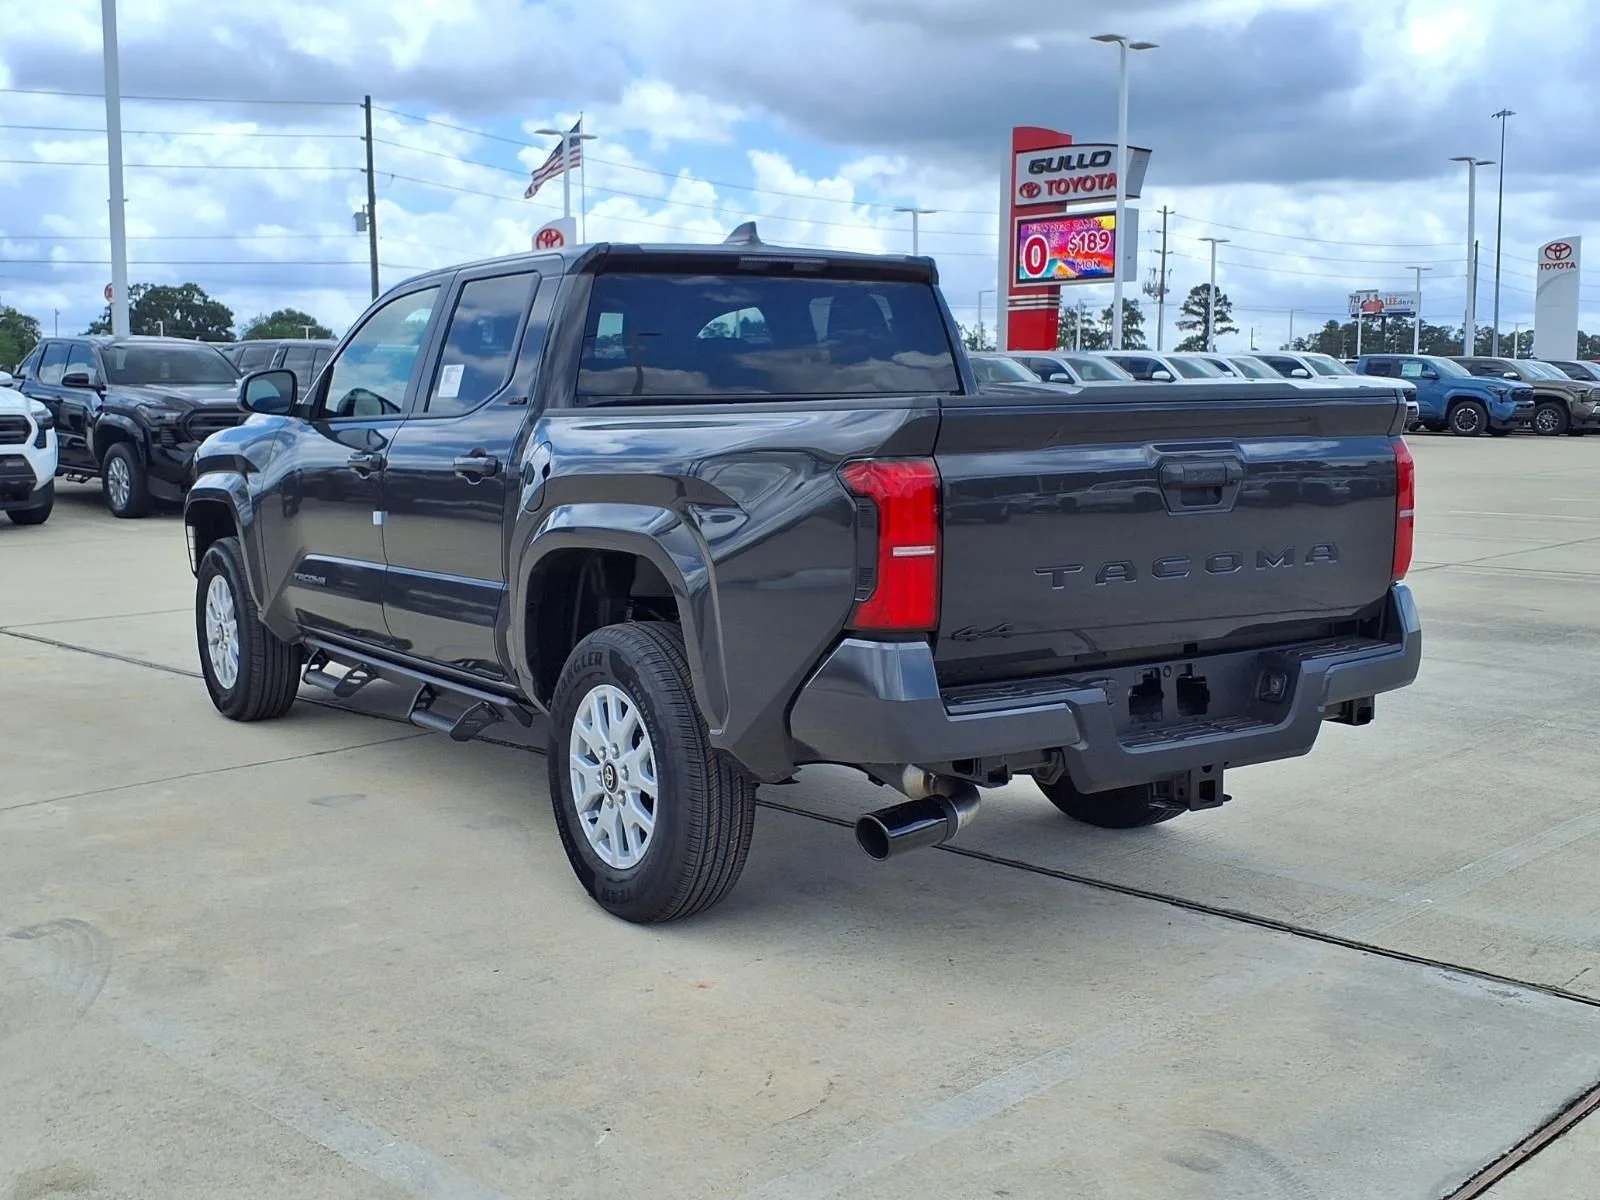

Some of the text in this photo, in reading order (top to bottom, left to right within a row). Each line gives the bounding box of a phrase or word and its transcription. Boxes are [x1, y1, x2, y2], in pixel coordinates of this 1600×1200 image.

[1028, 150, 1111, 175] GULLO
[1044, 173, 1118, 196] TOYOTA
[1067, 230, 1111, 255] $189
[1024, 235, 1048, 277] 0
[1539, 261, 1577, 270] TOYOTA
[1034, 542, 1339, 590] TACOMA
